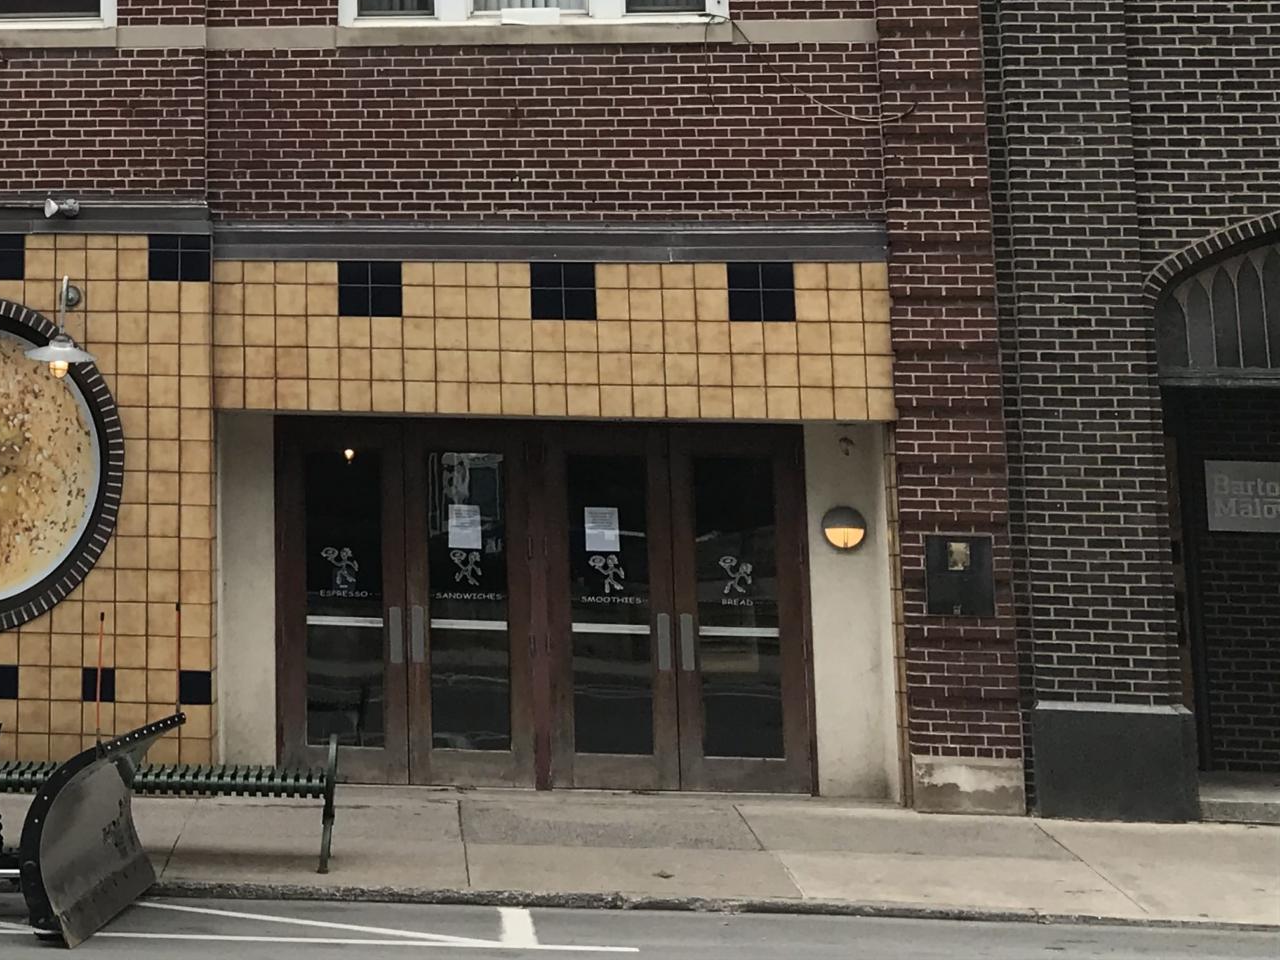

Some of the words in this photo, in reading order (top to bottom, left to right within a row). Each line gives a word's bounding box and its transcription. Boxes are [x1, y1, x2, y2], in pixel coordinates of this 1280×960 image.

[1215, 498, 1280, 519] Malo
[320, 589, 369, 598] ESPRESSO
[434, 592, 503, 601] SANDWICHES
[580, 596, 642, 605] SMOOTHIES
[721, 598, 754, 607] BREAD
